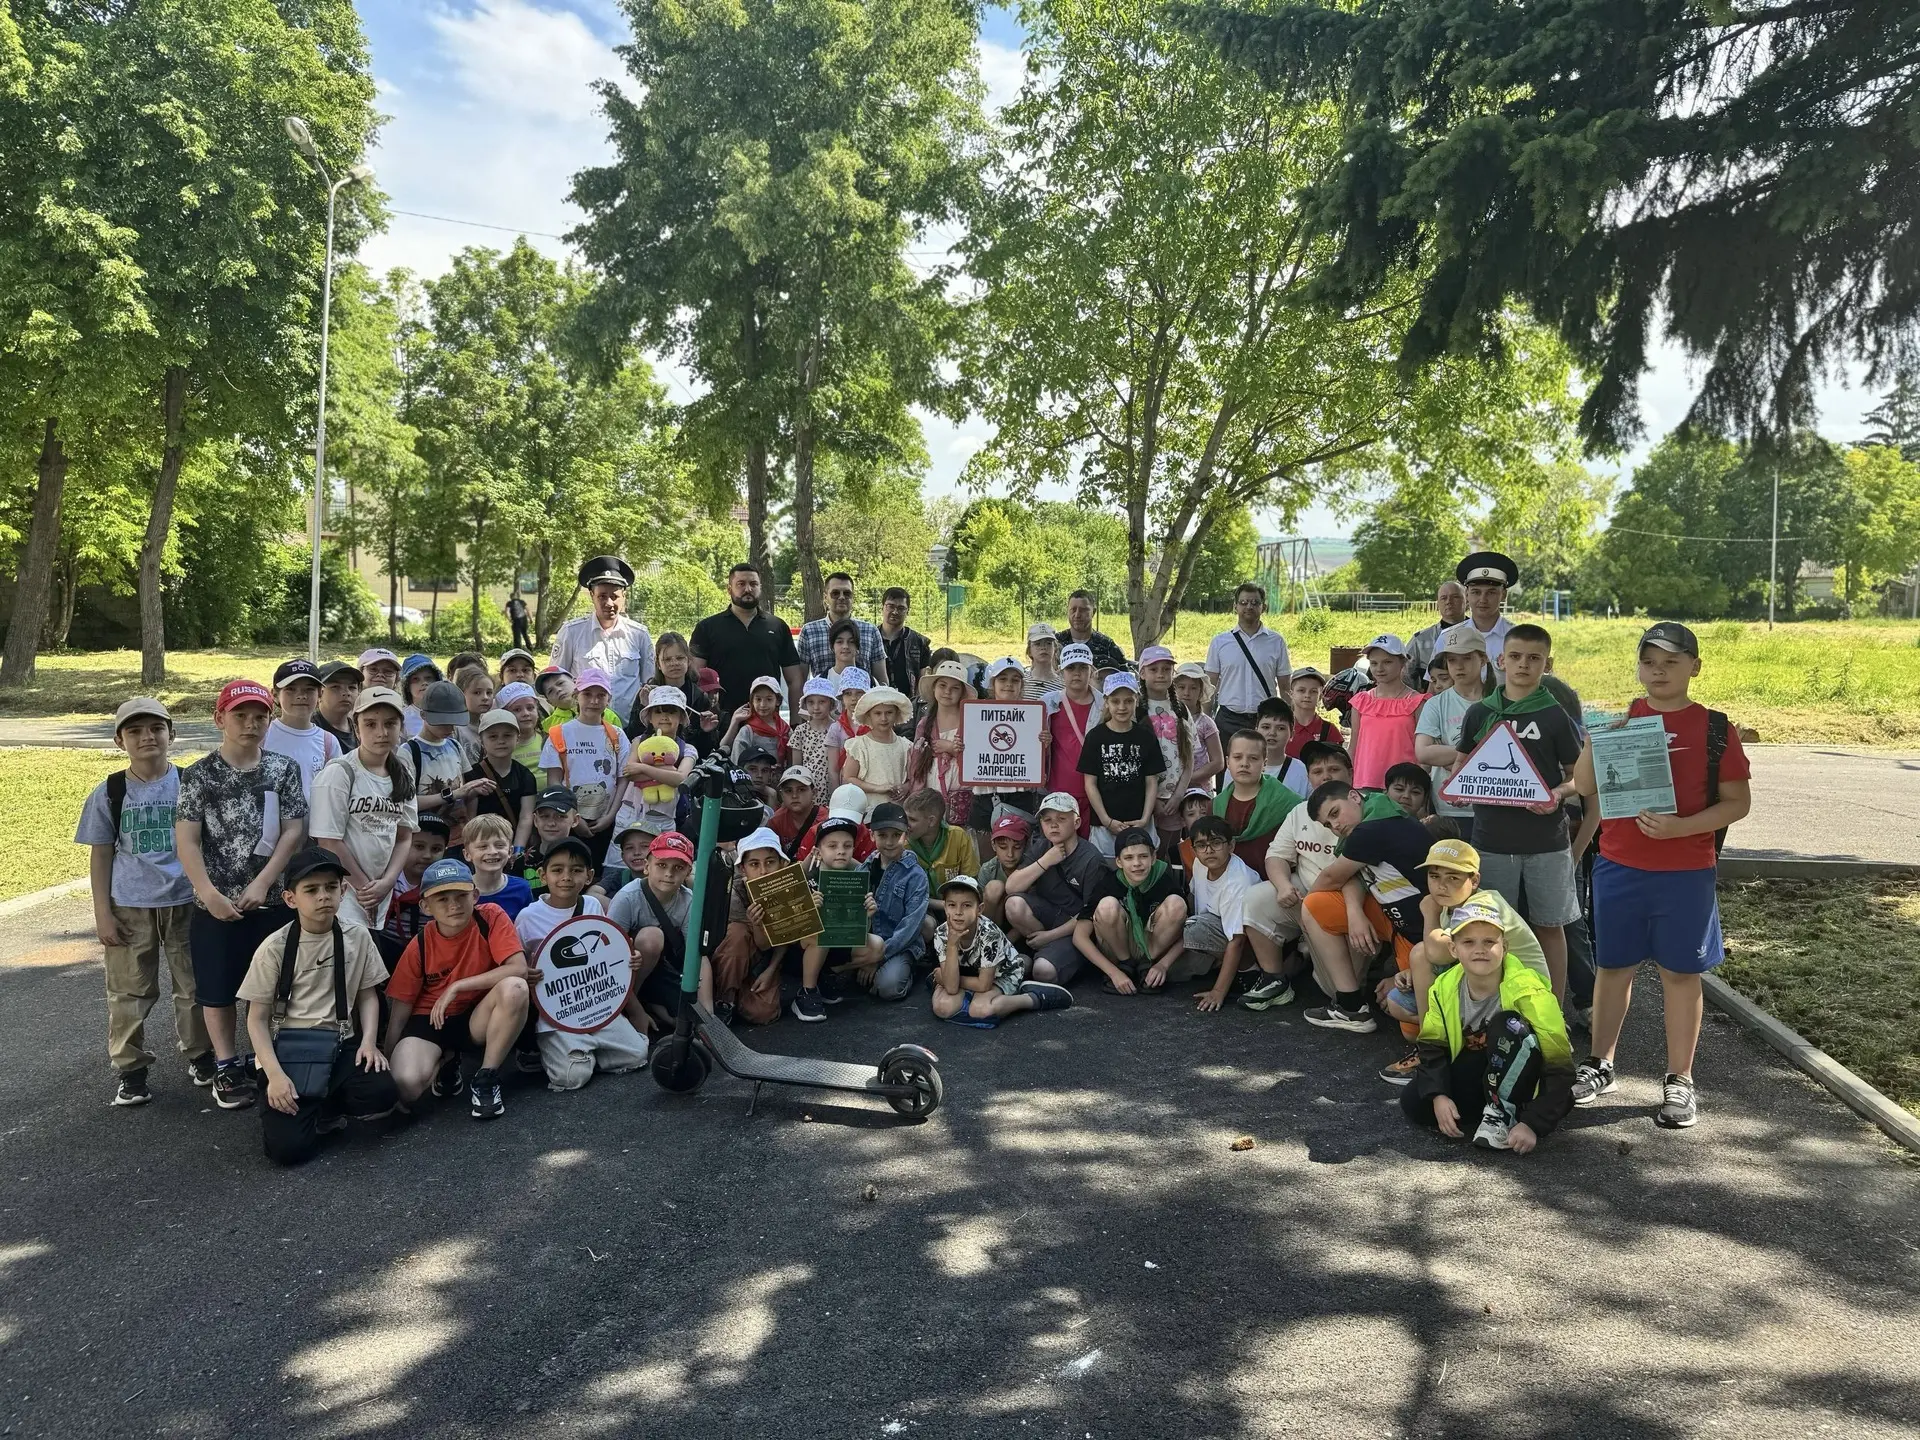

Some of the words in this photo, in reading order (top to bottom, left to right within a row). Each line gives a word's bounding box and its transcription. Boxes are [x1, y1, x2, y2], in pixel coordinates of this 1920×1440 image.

[230, 685, 268, 698] RUSSIA
[981, 708, 1025, 722] ПИТБАЙК
[1506, 720, 1541, 740] LA
[1101, 743, 1124, 758] LET
[1130, 743, 1140, 757] IT
[979, 753, 990, 764] НА
[992, 753, 1025, 765] ДОРОГЕ
[977, 765, 1026, 777] ЗАПРЕЩЕН!
[1102, 762, 1141, 777] SNOW
[1458, 775, 1529, 787] ЭЛЕКТРОСАМОКАТ
[1460, 784, 1474, 795] ПО
[1476, 785, 1535, 799] ПРАВИЛАМ!
[348, 796, 372, 814] LOS
[131, 829, 172, 854] 1991
[545, 961, 608, 997] МОТОЦИКЛ
[559, 993, 573, 1008] НЕ
[573, 975, 618, 1002] ИГРУШКА,
[556, 997, 594, 1020] СОБЛЮДАЙ
[594, 984, 626, 1005] СКОРОСТЬ!
